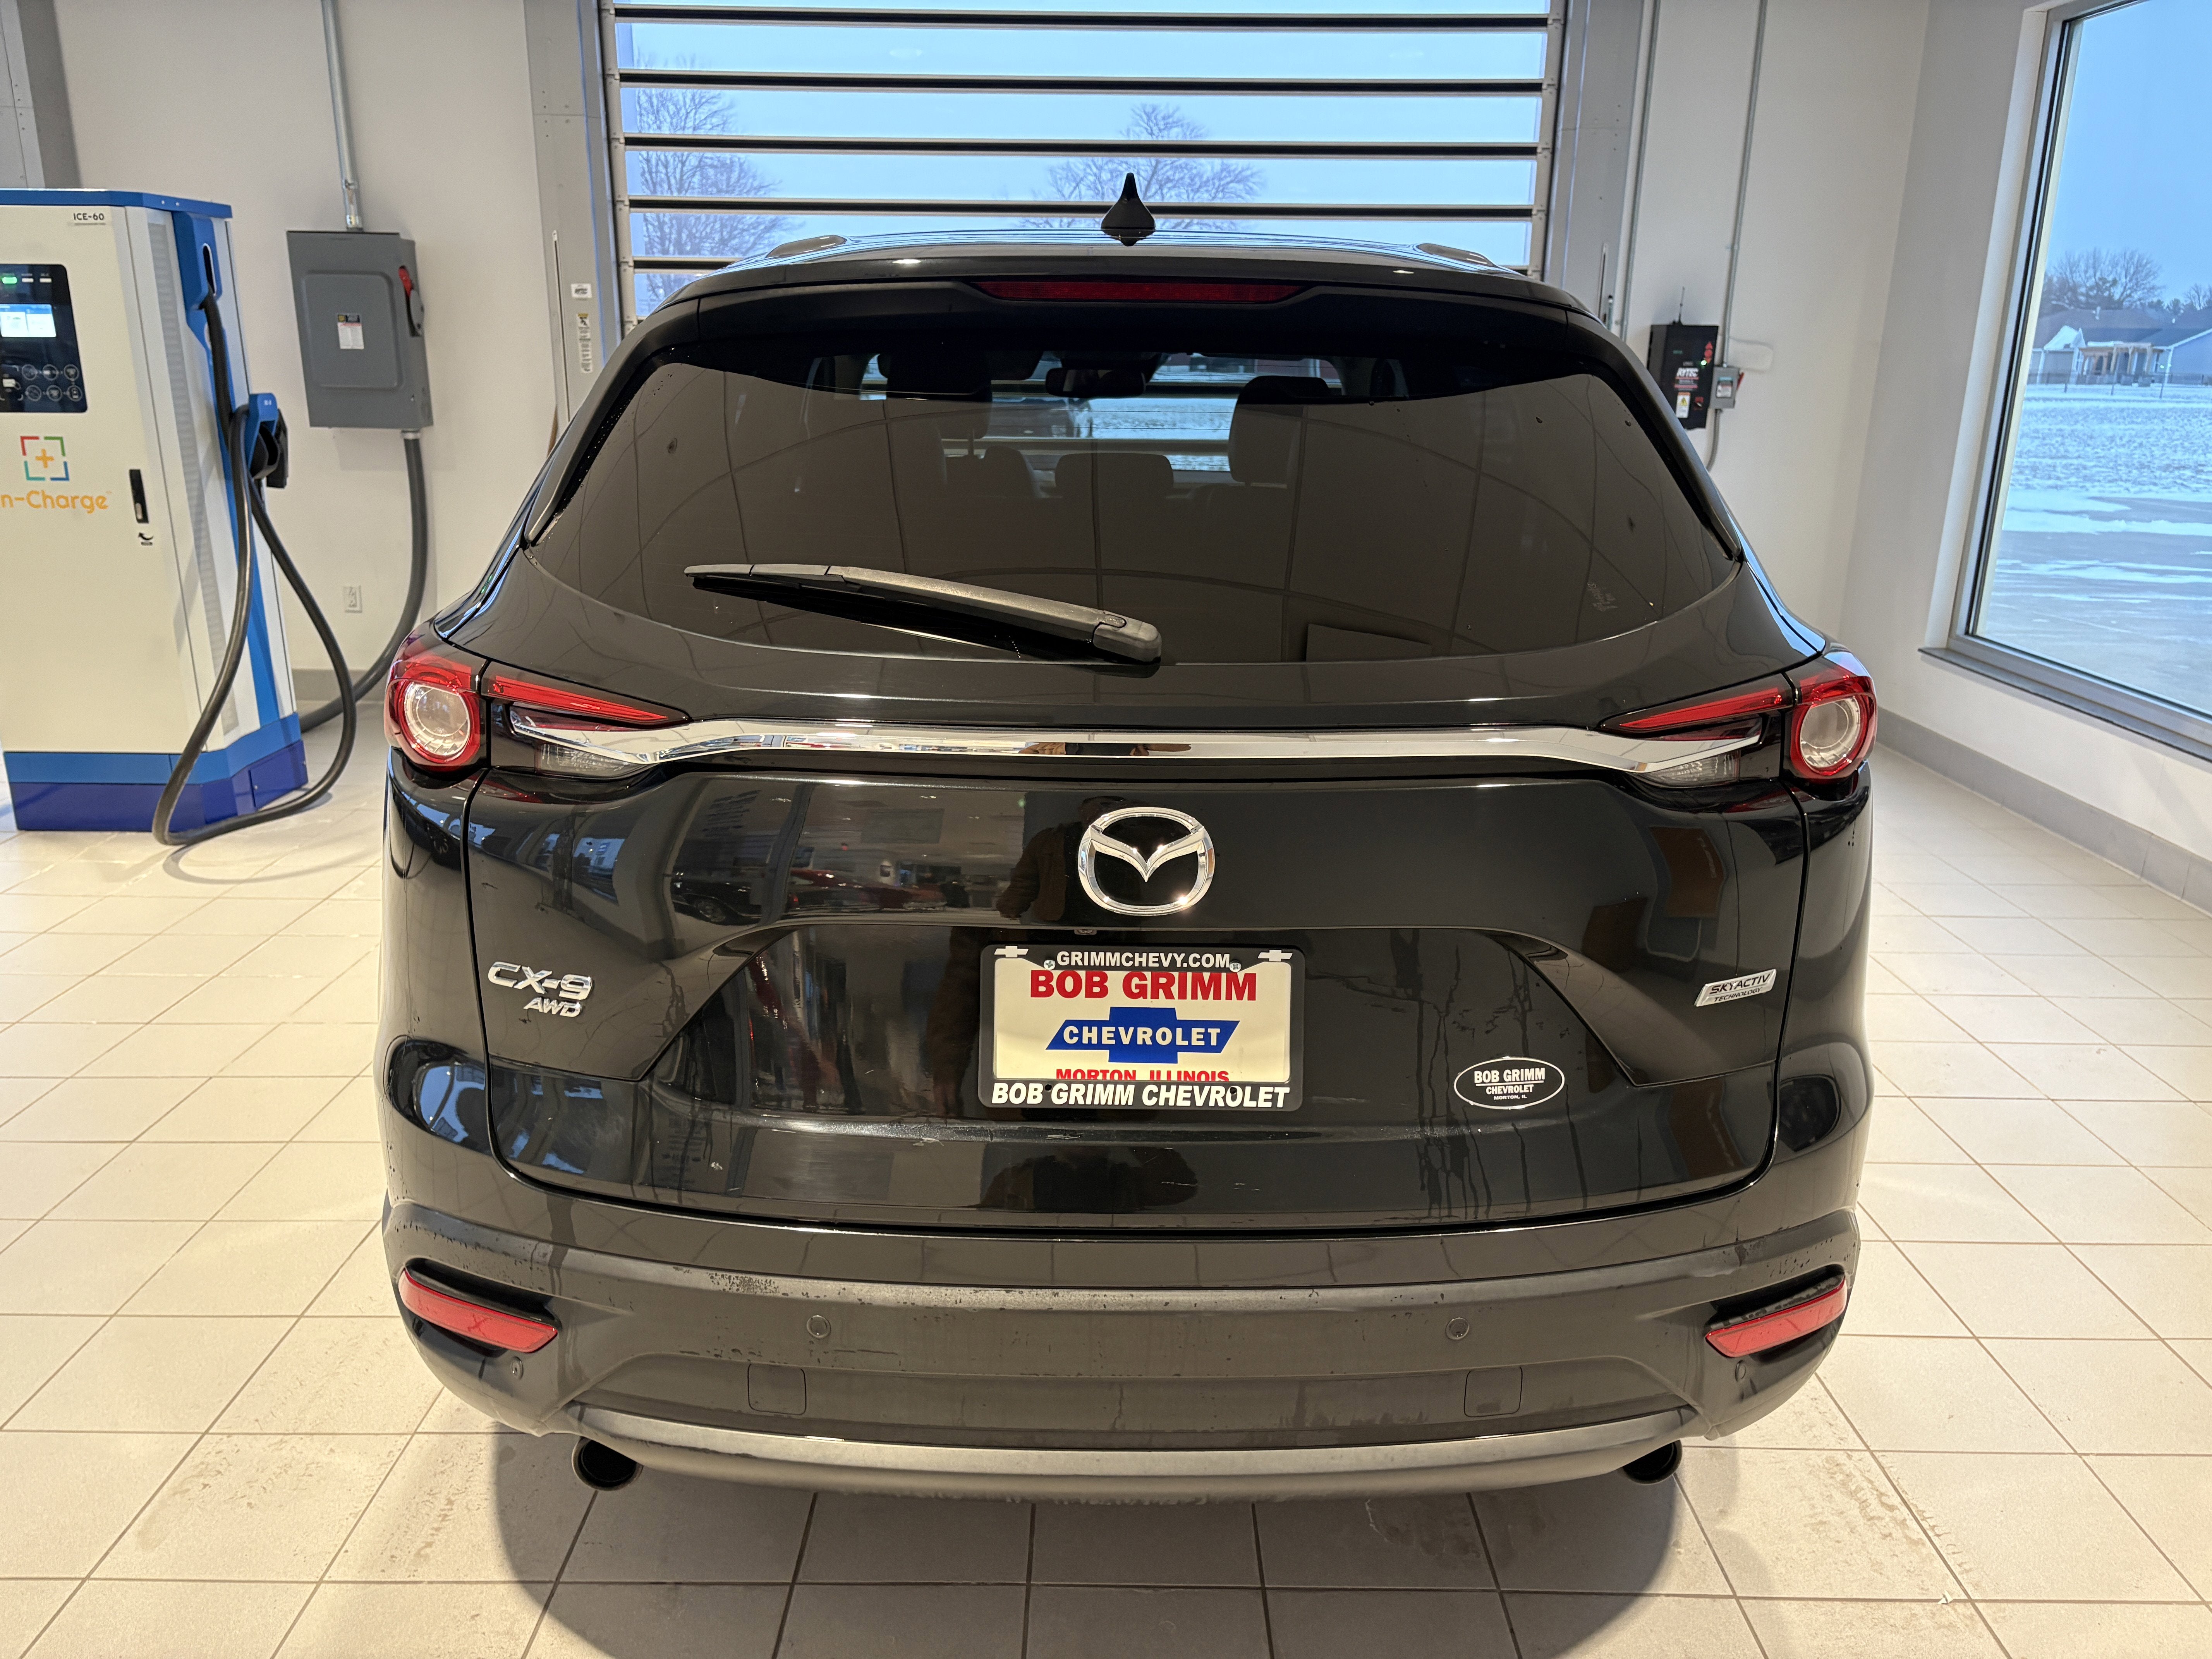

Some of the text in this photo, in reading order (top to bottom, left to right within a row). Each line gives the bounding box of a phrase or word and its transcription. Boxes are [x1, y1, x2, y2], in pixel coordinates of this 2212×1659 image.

[1057, 951, 1230, 968] GRIMMCHEVY.COM
[488, 962, 592, 1000] CX-9
[1030, 970, 1257, 1001] BOB GRIMM
[1709, 974, 1771, 994] SKYACTIV
[1714, 988, 1760, 1002] TECHNOLOGY
[524, 997, 582, 1017] AWD
[1063, 1026, 1220, 1046] CHEVROLET
[1474, 1068, 1545, 1083] BOB GRIMM
[992, 1083, 1290, 1108] BOB GRIMM CHEVROLET
[1486, 1084, 1534, 1094] CHEVROLET
